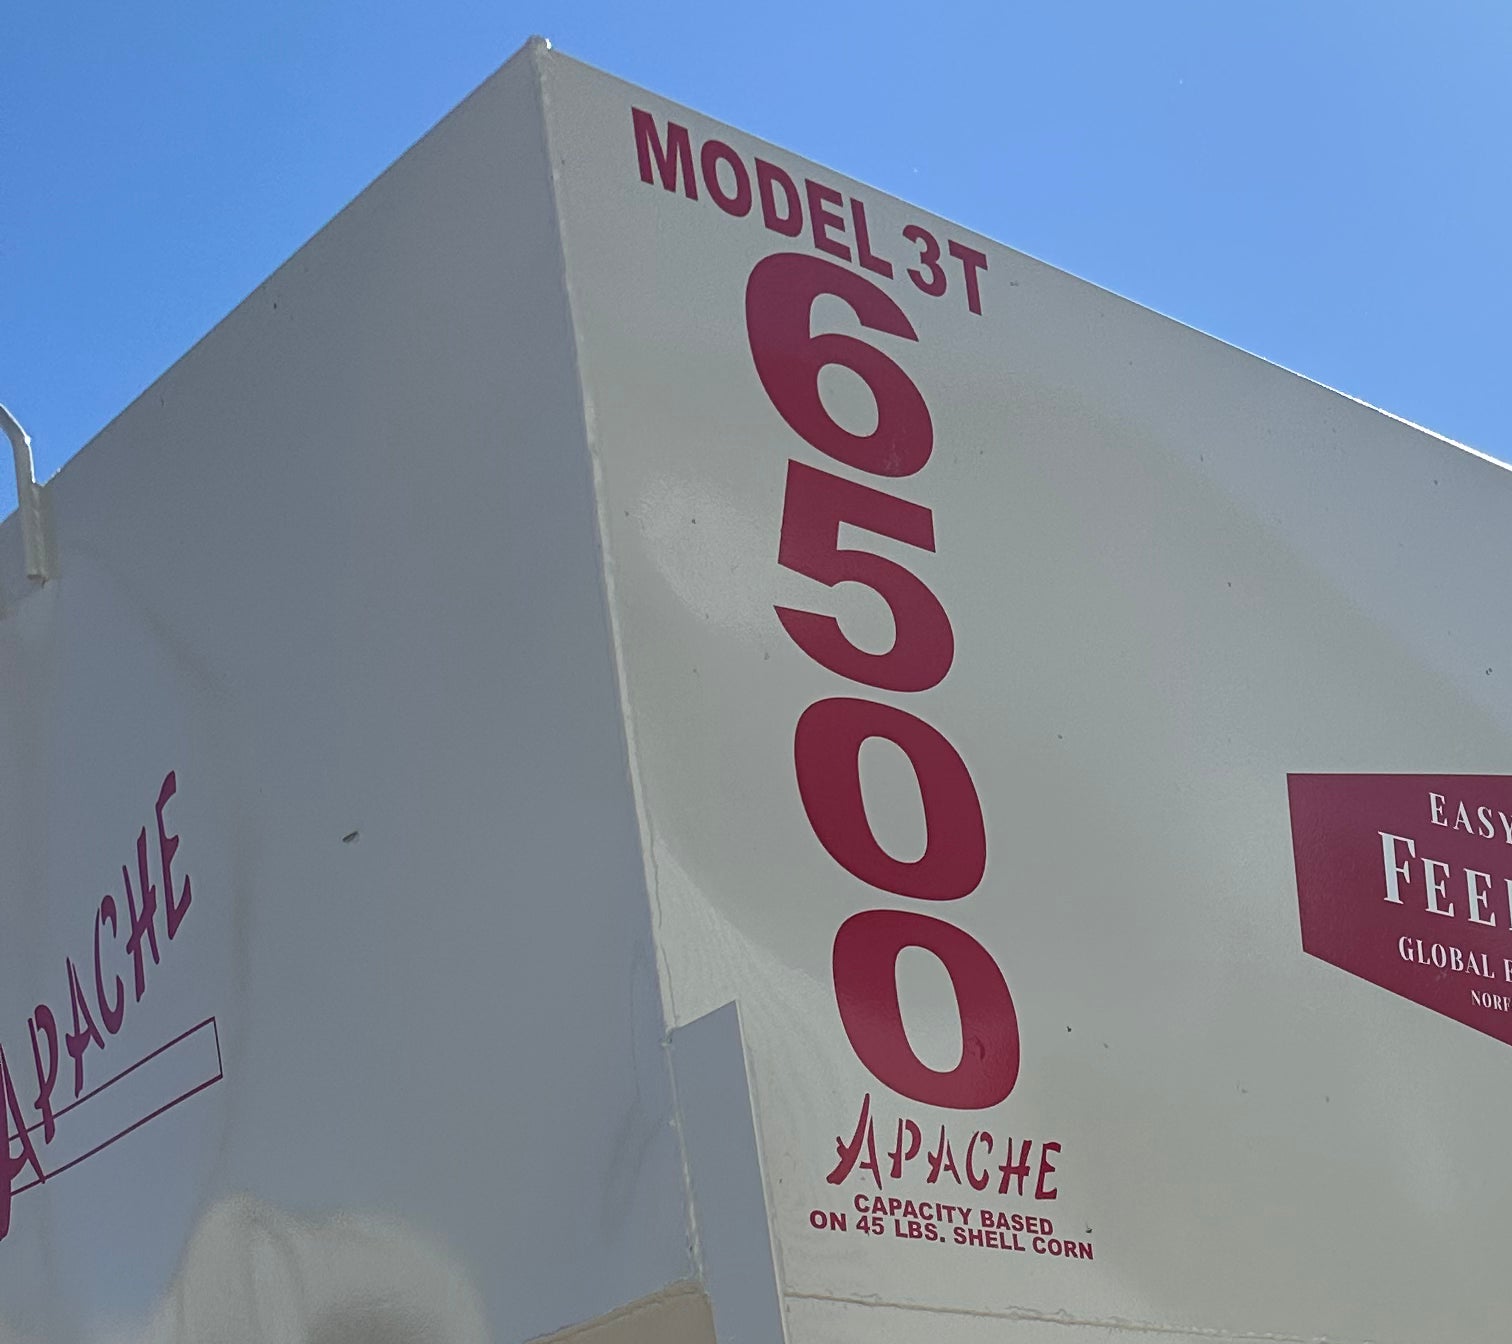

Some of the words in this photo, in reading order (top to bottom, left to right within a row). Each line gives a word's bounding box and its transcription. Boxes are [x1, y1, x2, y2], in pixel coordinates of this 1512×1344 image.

[631, 106, 893, 280] MODEL
[903, 224, 988, 316] 3T
[745, 252, 1020, 1110] 6500
[1398, 936, 1495, 979] GLOBAL
[826, 1093, 1062, 1200] APACHE
[809, 1210, 847, 1231] ON
[856, 1215, 885, 1236] 45
[894, 1219, 946, 1242] LBS.
[953, 1226, 1026, 1251] SHELL
[1032, 1237, 1094, 1260] CORN
[854, 1194, 972, 1225] CAPACITY
[980, 1210, 1054, 1235] BASED
